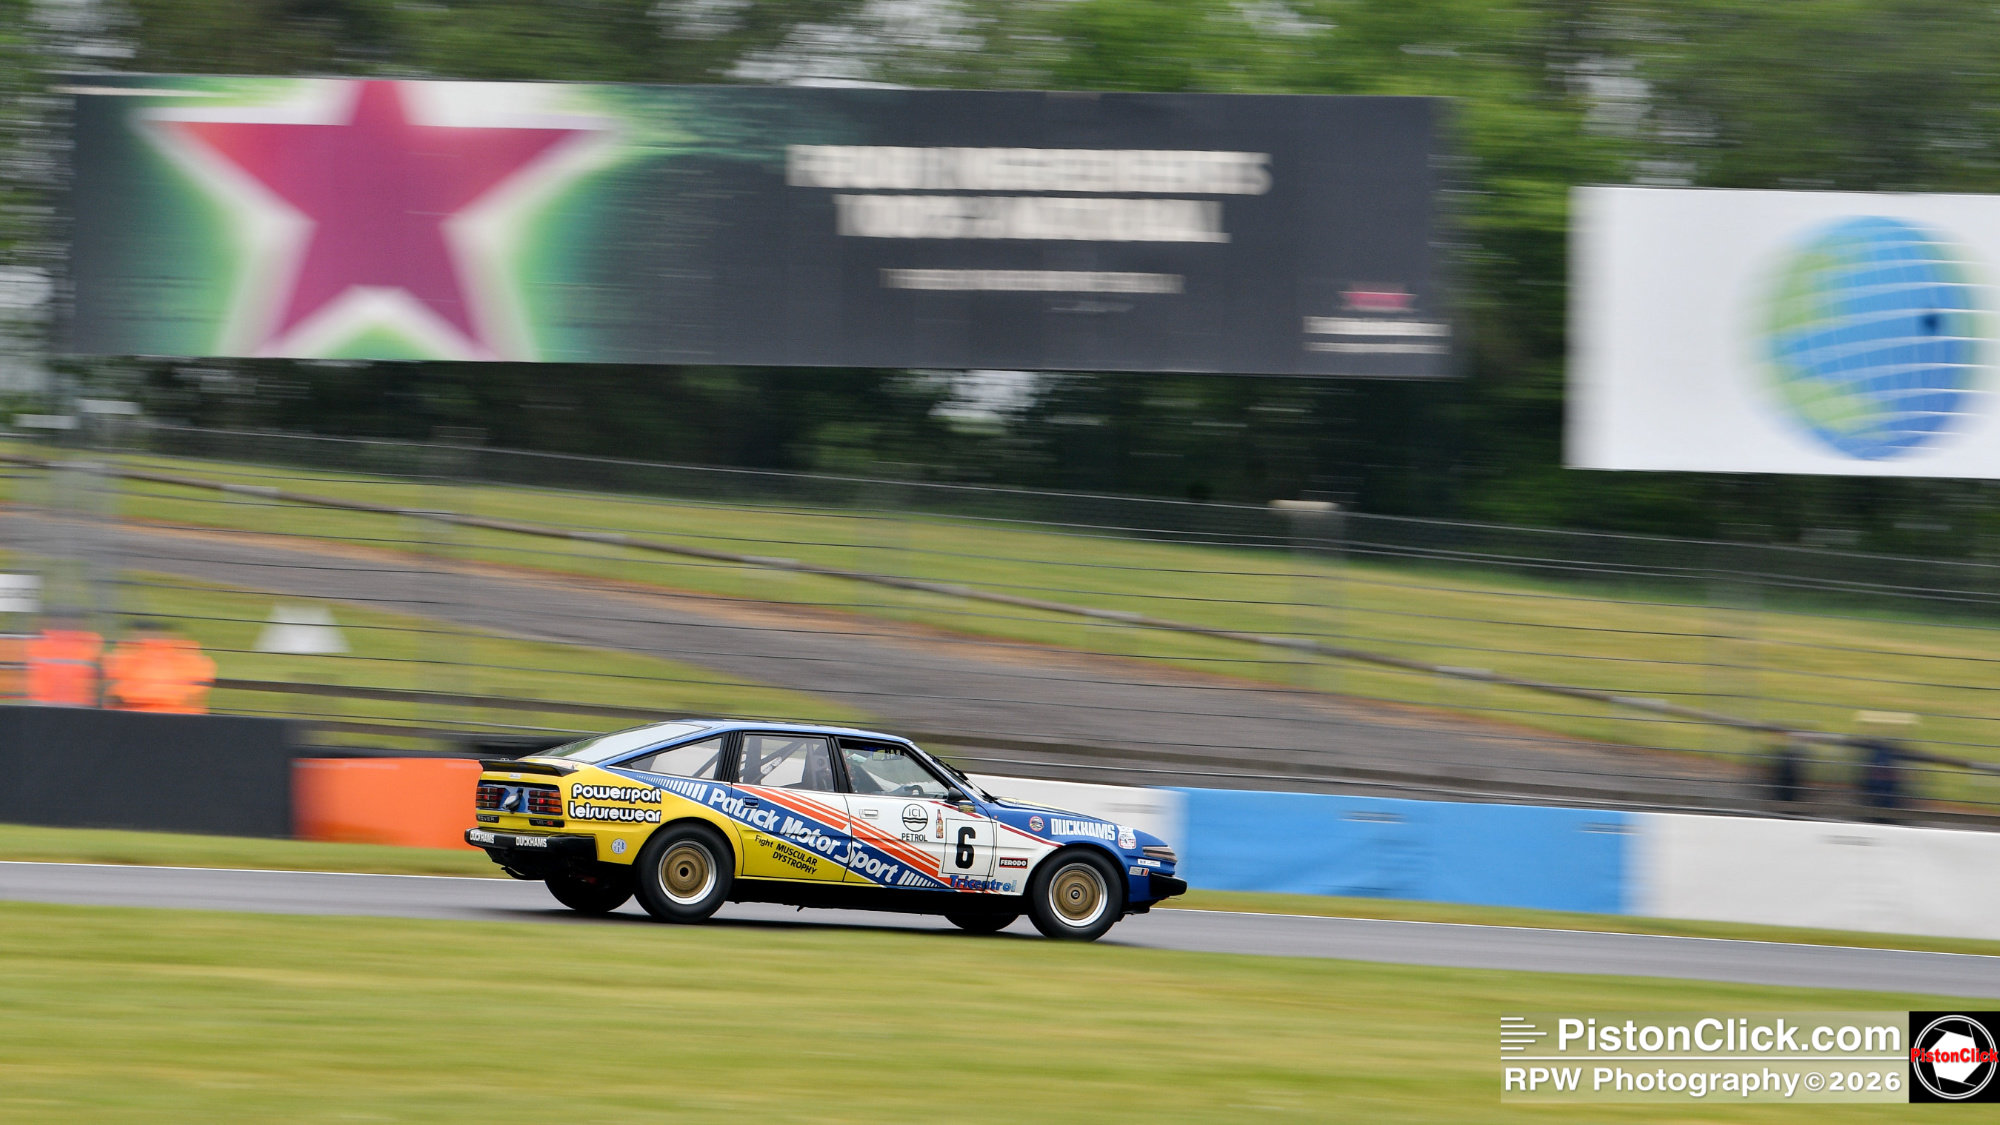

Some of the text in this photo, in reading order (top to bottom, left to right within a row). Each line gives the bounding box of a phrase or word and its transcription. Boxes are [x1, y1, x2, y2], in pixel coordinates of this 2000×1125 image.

[572, 783, 661, 804] Powersport
[569, 801, 661, 823] Leisurewear
[908, 808, 921, 818] ICI
[469, 829, 495, 844] DUCKHAMS
[708, 788, 899, 883] Patrick Motor Sport
[901, 832, 928, 843] PETROL
[1050, 818, 1116, 841] DUCKHAMS
[515, 836, 548, 848] DUCKHAMS
[754, 834, 818, 866] Fight MUSCULAR
[955, 826, 976, 869] 6
[772, 851, 818, 875] DYSTROPHY
[1000, 859, 1027, 867] FERODO
[949, 874, 1018, 893] Tricentrol
